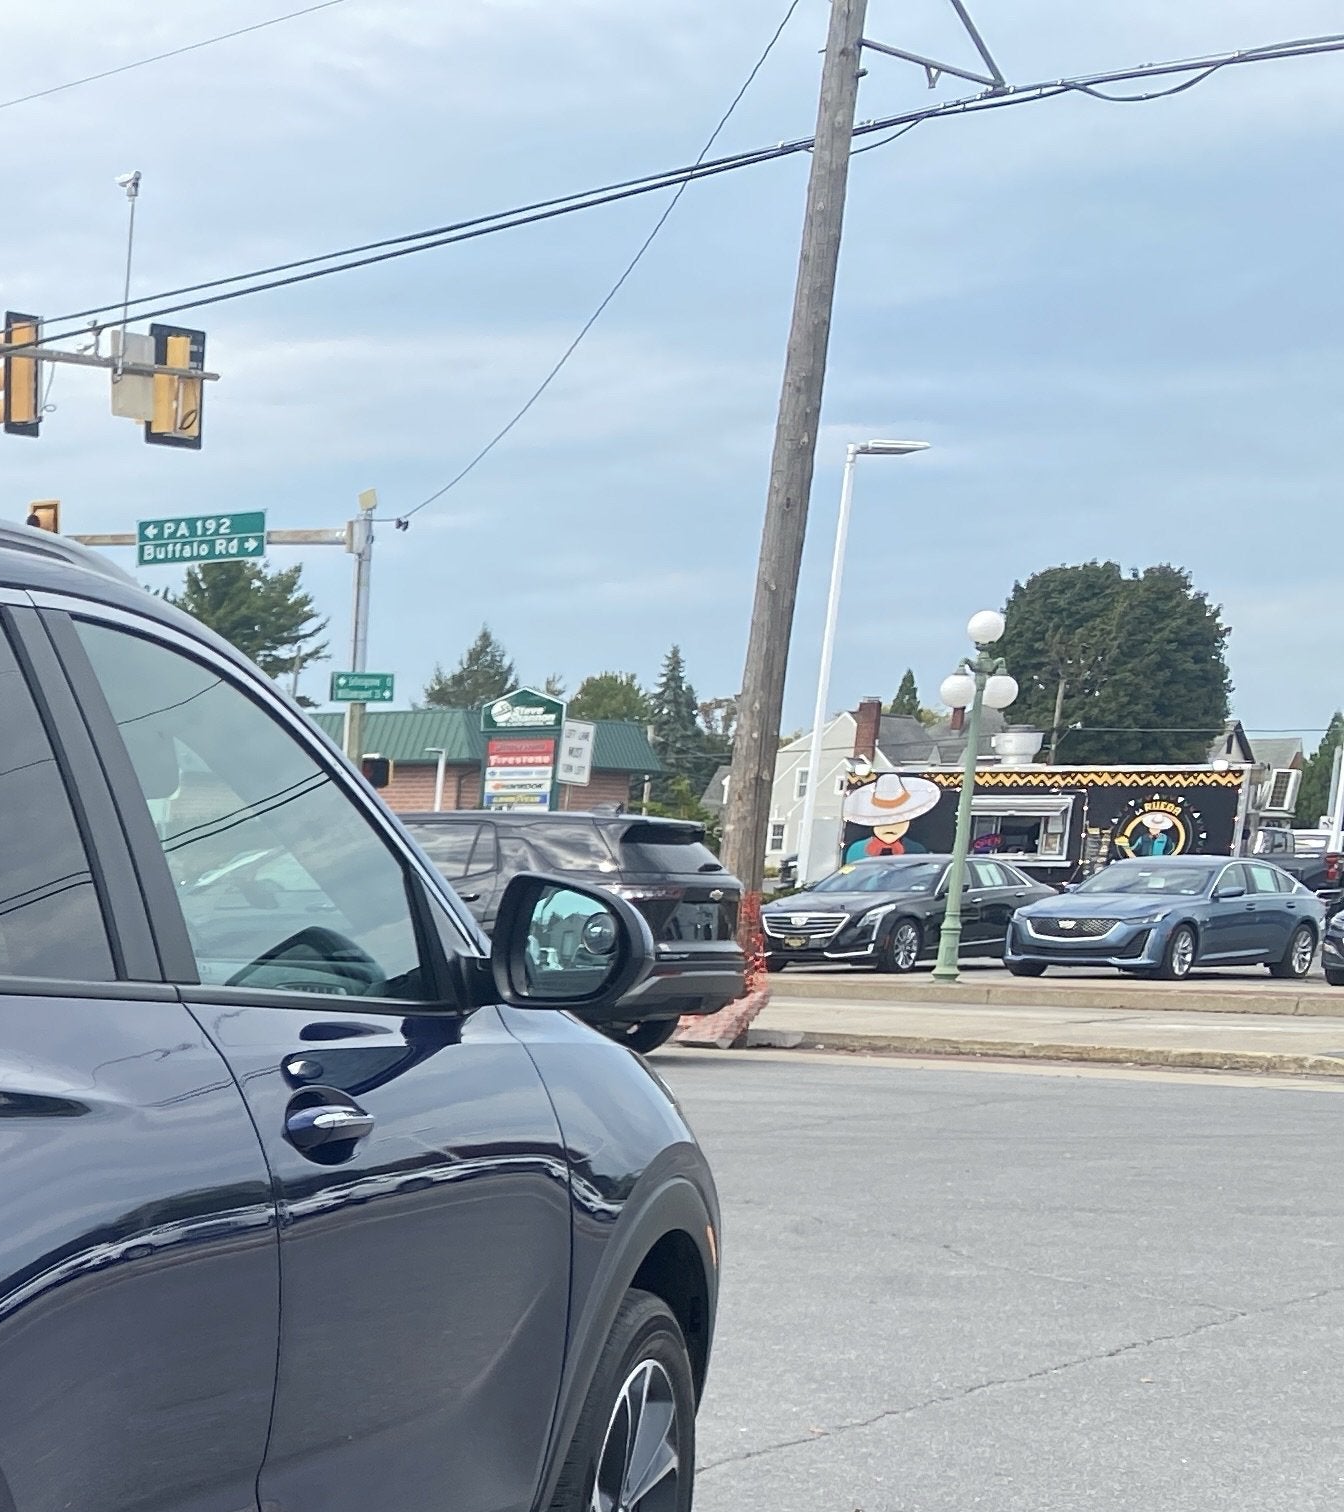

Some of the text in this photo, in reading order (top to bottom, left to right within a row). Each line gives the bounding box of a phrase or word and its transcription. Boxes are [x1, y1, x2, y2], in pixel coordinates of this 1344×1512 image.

[162, 517, 231, 539] PA 192
[142, 537, 239, 560] Buffalo Rd
